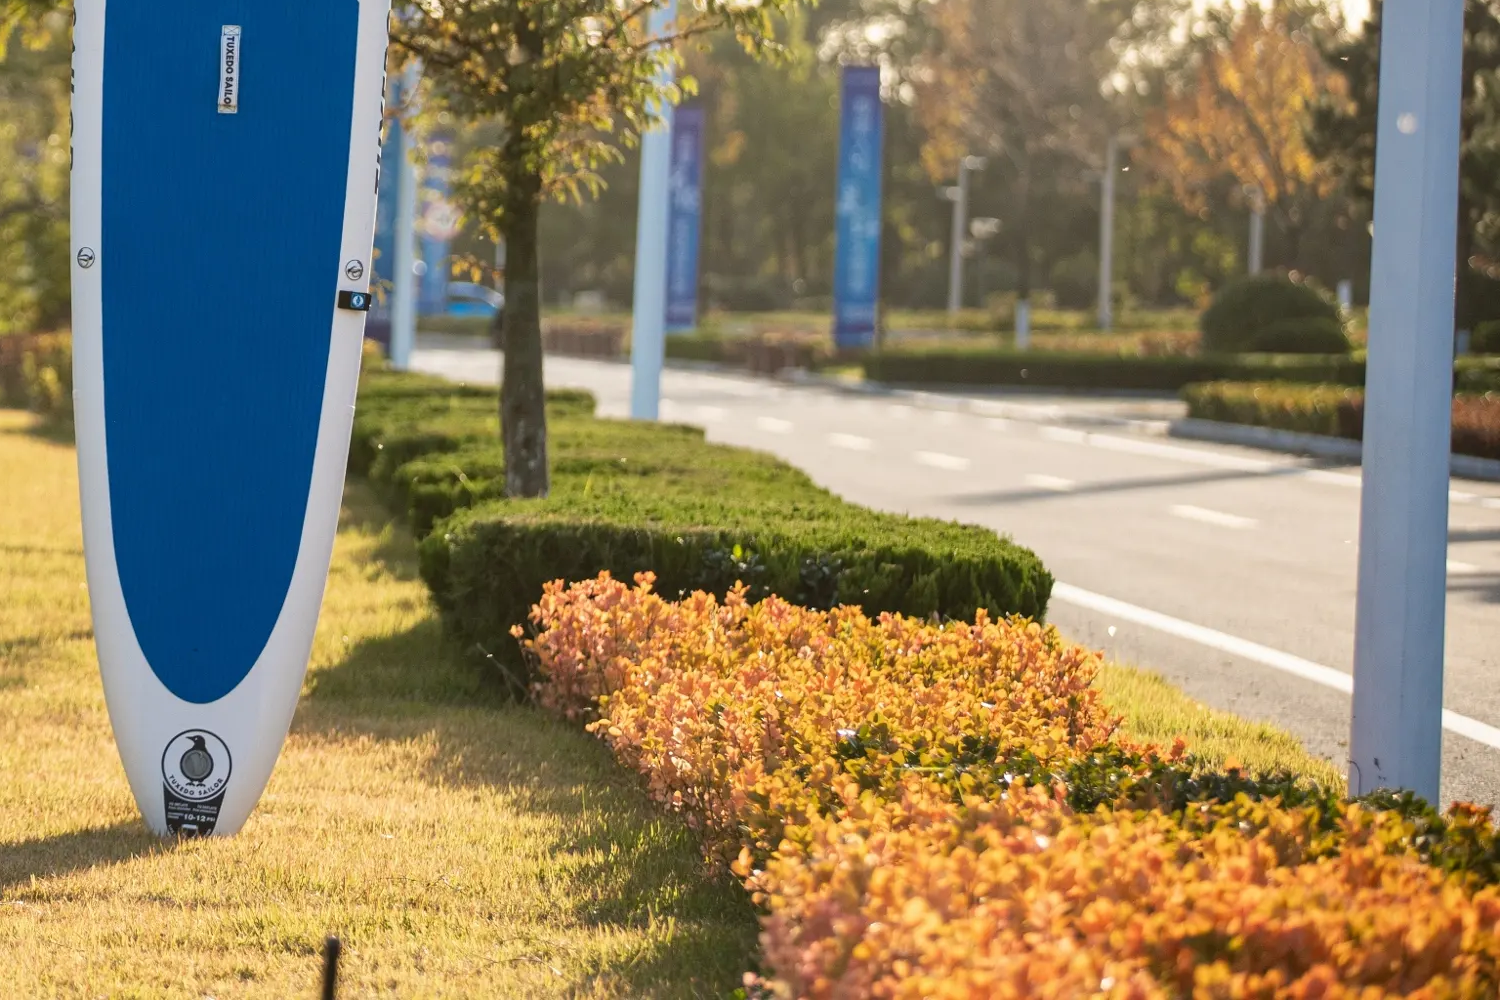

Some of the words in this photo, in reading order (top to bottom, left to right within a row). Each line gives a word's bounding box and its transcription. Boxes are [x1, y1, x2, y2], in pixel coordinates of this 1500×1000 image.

[225, 35, 235, 75] TUXEDO
[223, 76, 234, 107] SAILO
[169, 773, 195, 796] TUXEDO
[198, 777, 224, 796] SAILOR
[184, 813, 206, 822] 10-12
